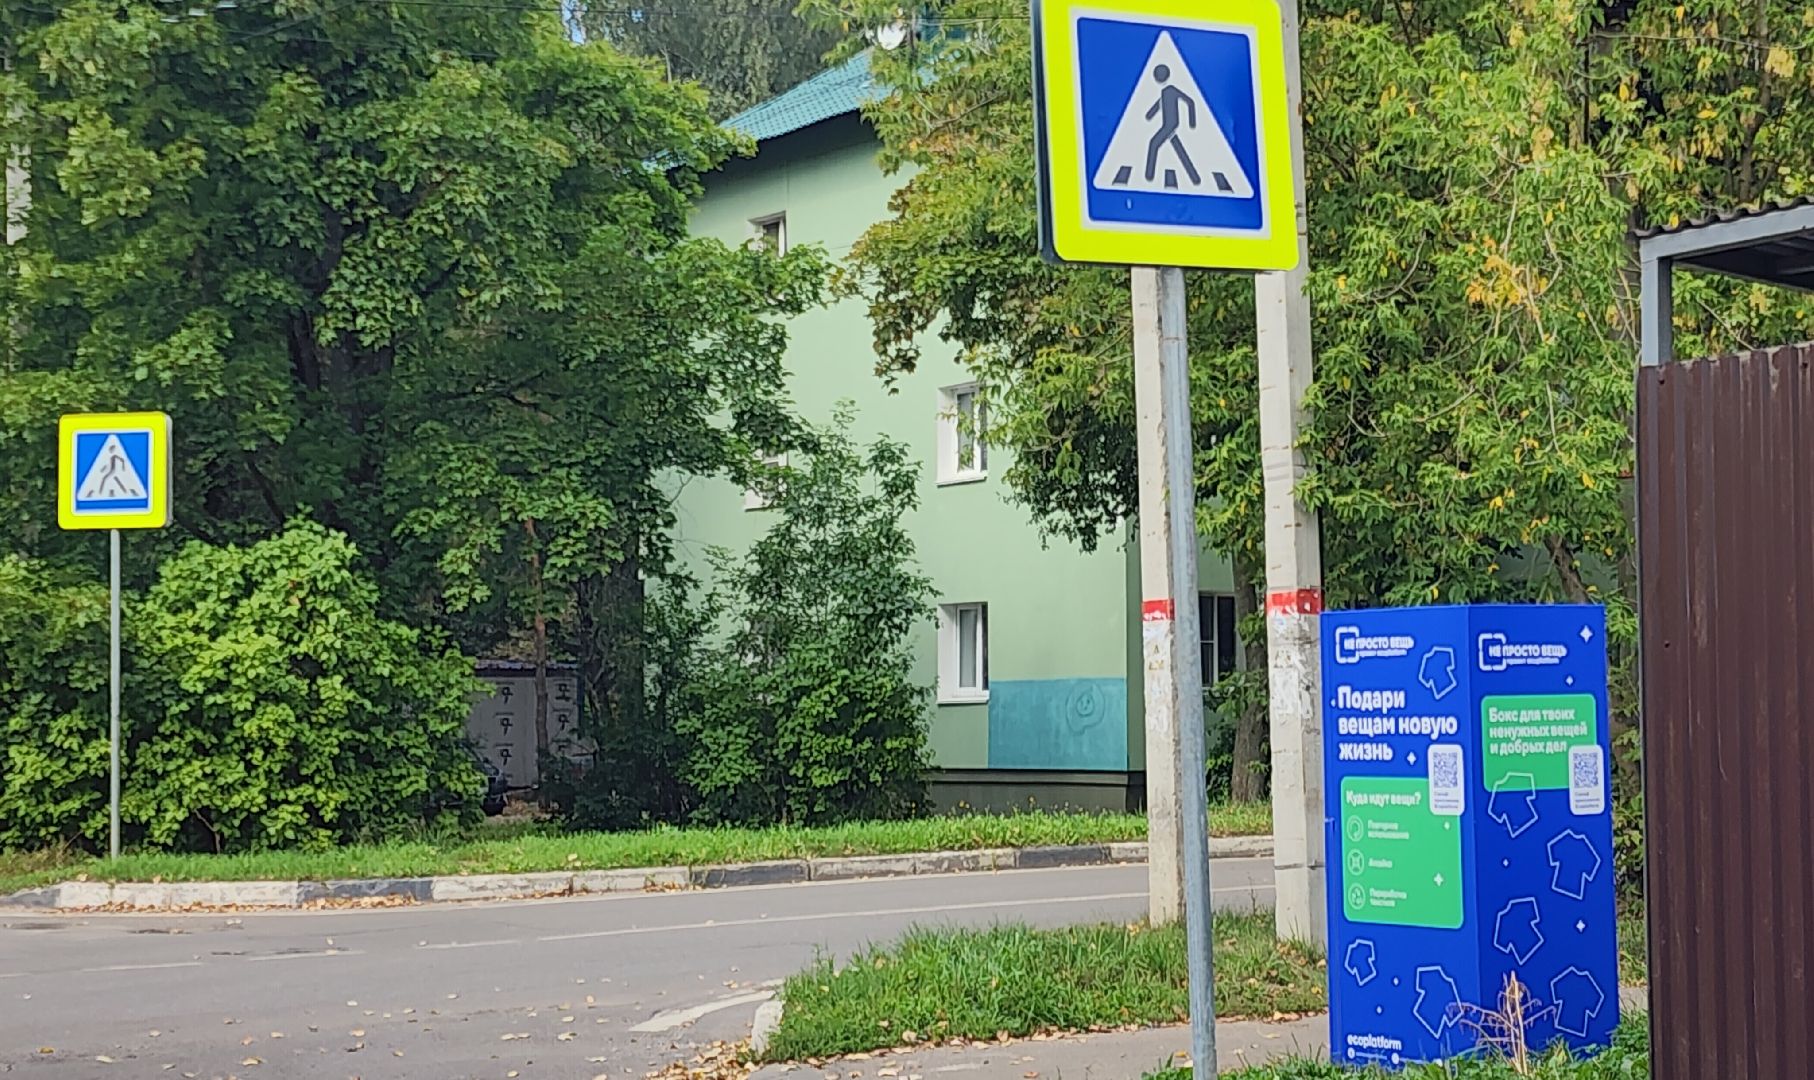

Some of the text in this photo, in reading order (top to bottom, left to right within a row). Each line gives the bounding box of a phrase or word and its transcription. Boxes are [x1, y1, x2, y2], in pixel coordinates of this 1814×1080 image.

[1356, 637, 1389, 649] ПРОСТО
[1502, 644, 1540, 657] ПРОСТО
[1337, 685, 1405, 714] Подари
[1488, 707, 1575, 723] Бокс для твоих
[1338, 716, 1458, 740] вещам новую
[1489, 721, 1588, 740] ненужных вещей
[1338, 742, 1394, 761] жизнь
[1490, 739, 1567, 757] и добрых дел
[1346, 790, 1421, 808] Куда идут вещи?
[1347, 1033, 1402, 1051] ecoplatform
